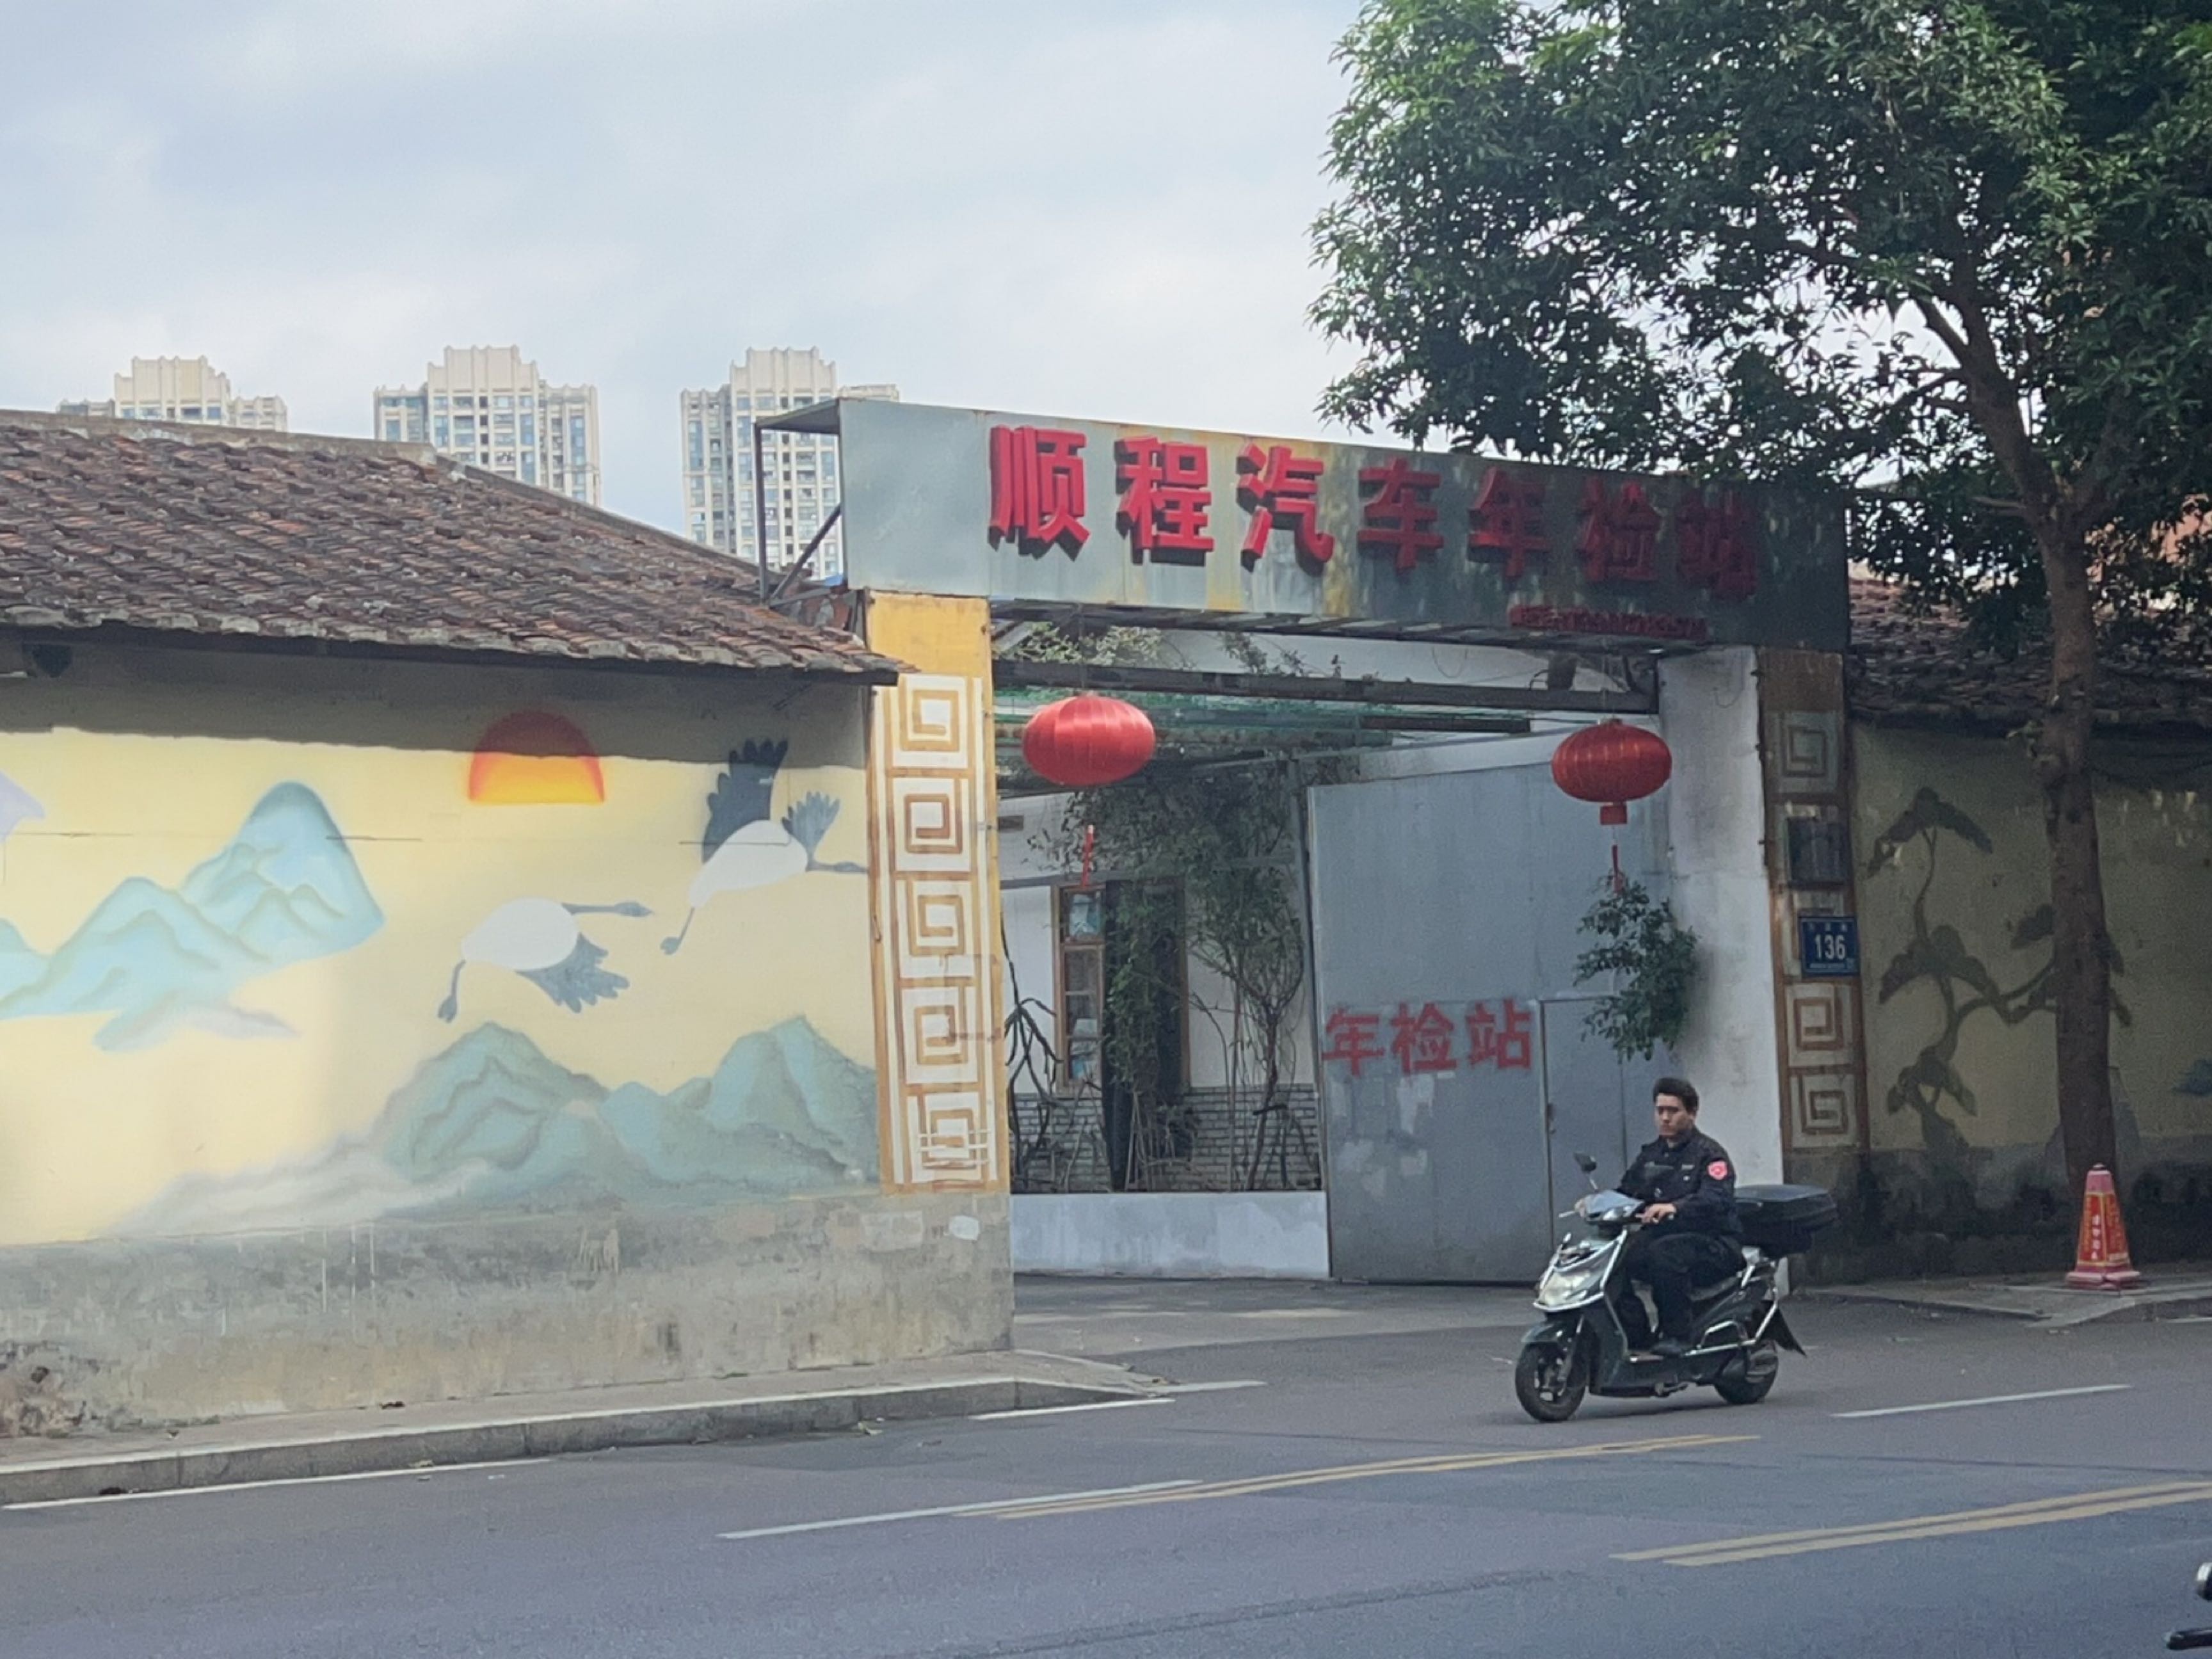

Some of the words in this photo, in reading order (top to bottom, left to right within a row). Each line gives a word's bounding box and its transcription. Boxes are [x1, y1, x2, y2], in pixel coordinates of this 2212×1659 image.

[988, 425, 1759, 602] 顺程汽车年检站
[1815, 934, 1846, 959] 136
[1322, 998, 1532, 1078] 年检站
